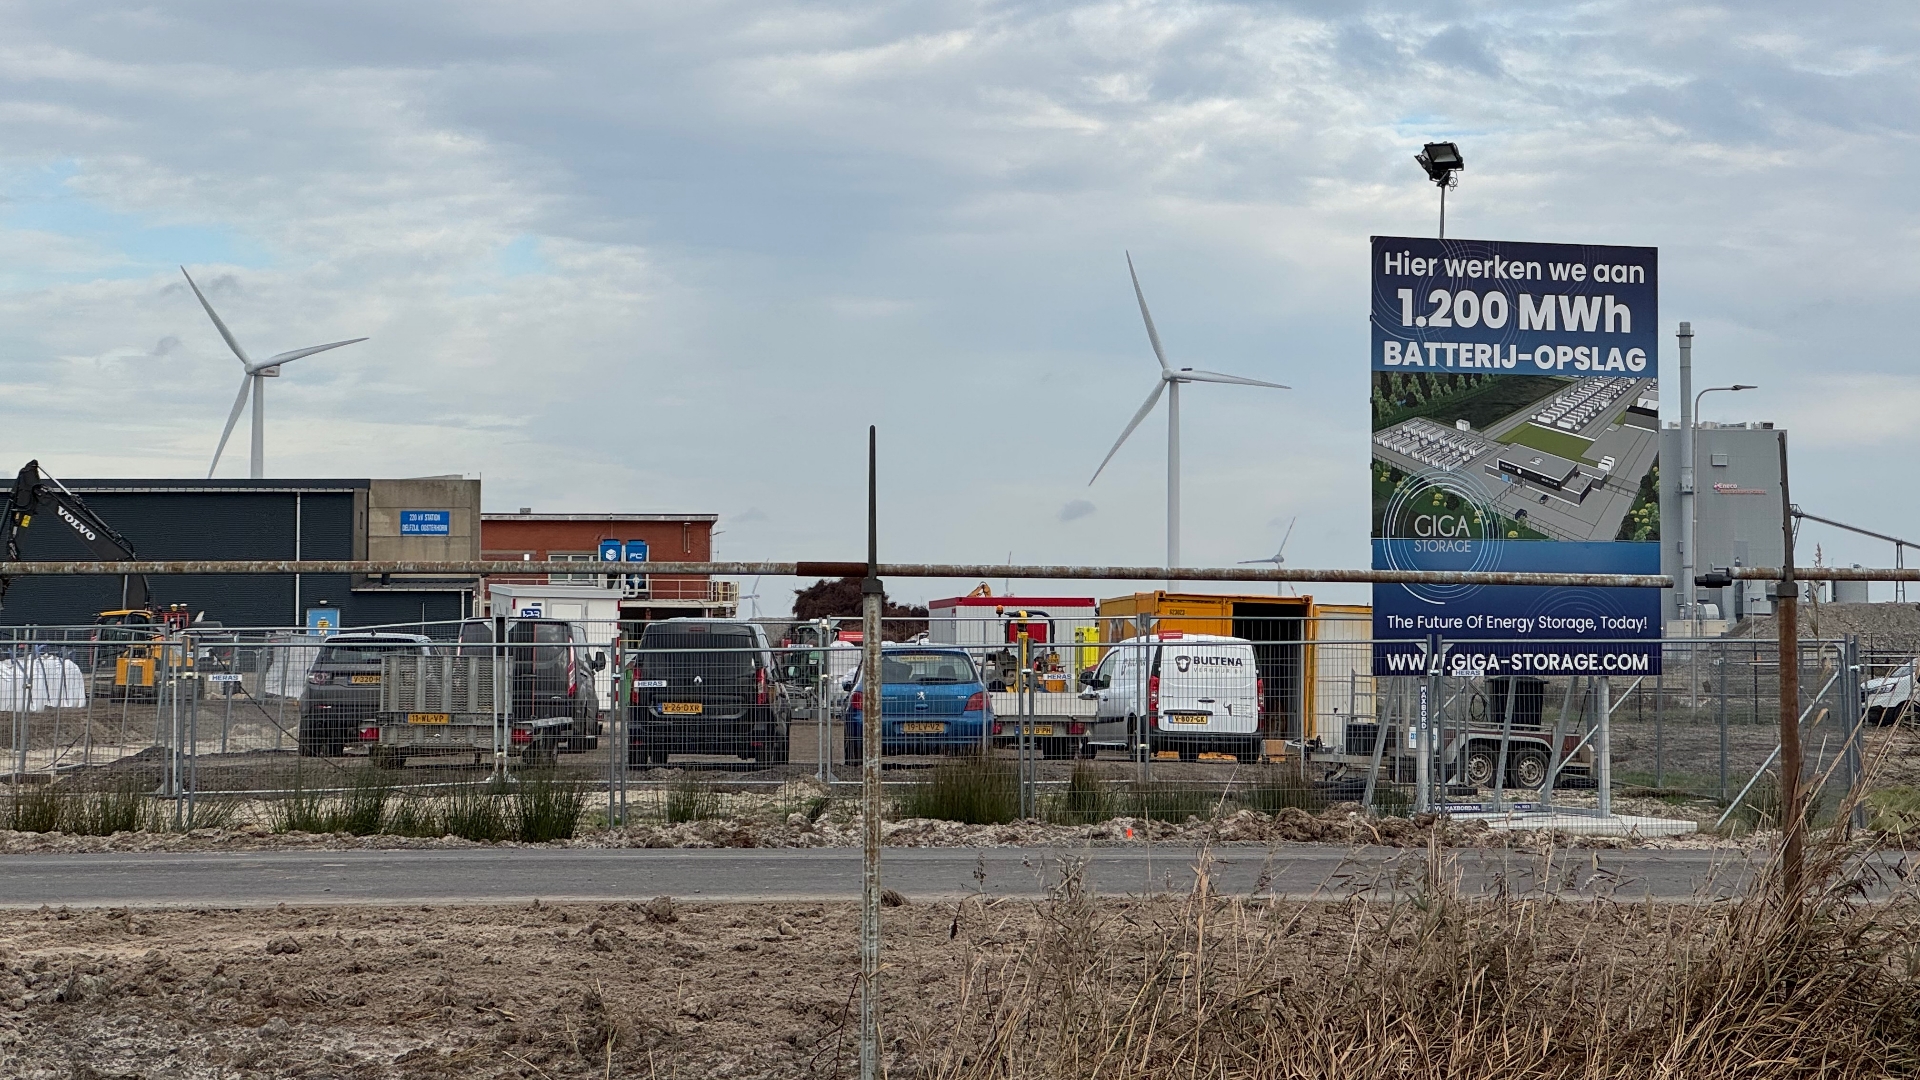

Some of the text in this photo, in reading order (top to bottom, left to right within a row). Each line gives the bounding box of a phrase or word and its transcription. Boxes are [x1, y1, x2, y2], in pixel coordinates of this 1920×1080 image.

[1384, 250, 1645, 284] Hier werken we aan
[1398, 288, 1631, 334] 1.200 MWh
[1384, 340, 1647, 372] BATTERIJ-OPSLAG
[57, 505, 96, 541] VOLVO
[1414, 514, 1471, 537] GIGA
[1414, 540, 1472, 553] STORAGE
[1387, 615, 1648, 633] The Future Of Energy Storage, Today!
[1194, 656, 1243, 666] BULTENA
[664, 703, 700, 712] V-26-DXR
